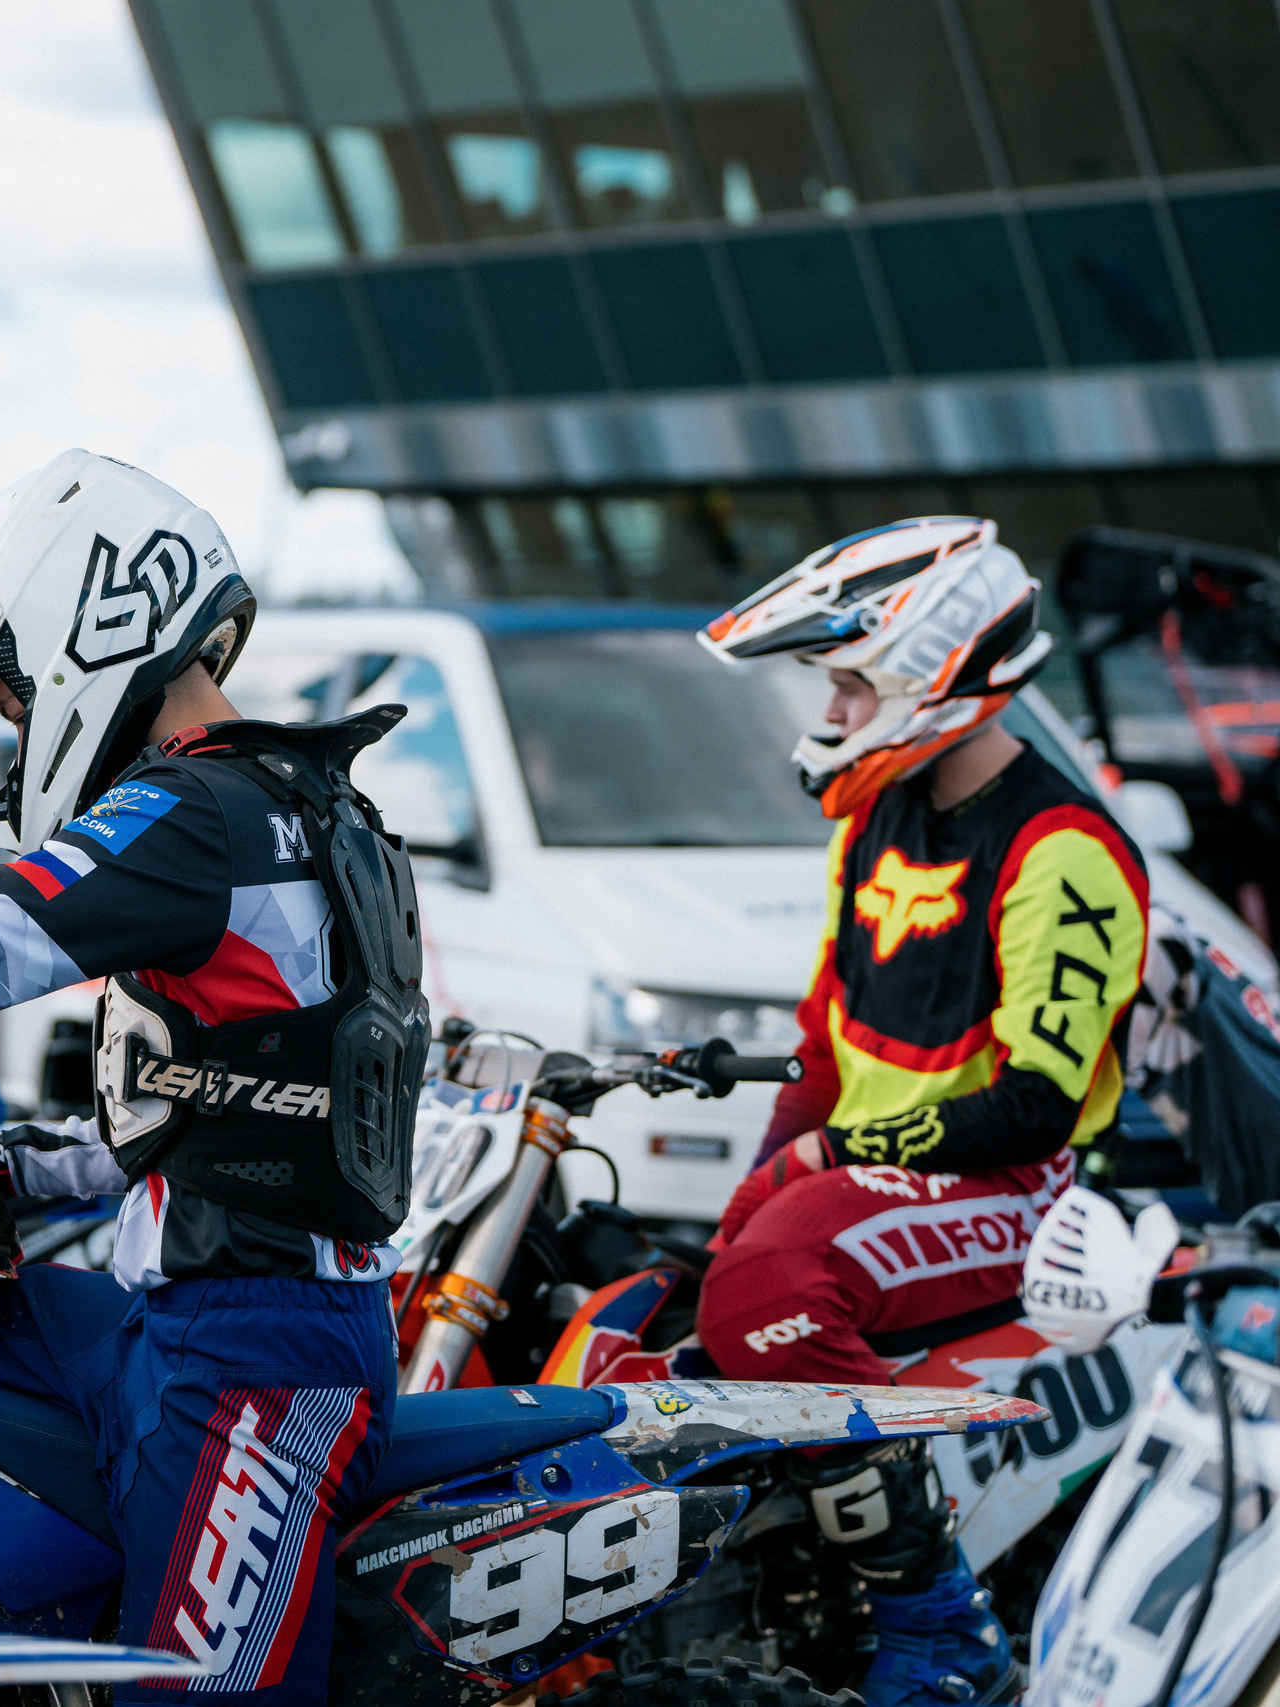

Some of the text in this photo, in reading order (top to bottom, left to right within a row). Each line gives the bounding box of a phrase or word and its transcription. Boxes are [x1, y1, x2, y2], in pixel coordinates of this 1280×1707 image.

[64, 529, 197, 673] 6D
[73, 815, 116, 839] ССИИ
[1030, 877, 1117, 1070] FOX
[936, 1210, 1033, 1260] FOX
[745, 1312, 822, 1354] FOX
[356, 1502, 524, 1577] МАКСИМЮК ВАСИЛИЙ
[449, 1492, 680, 1665] 99
